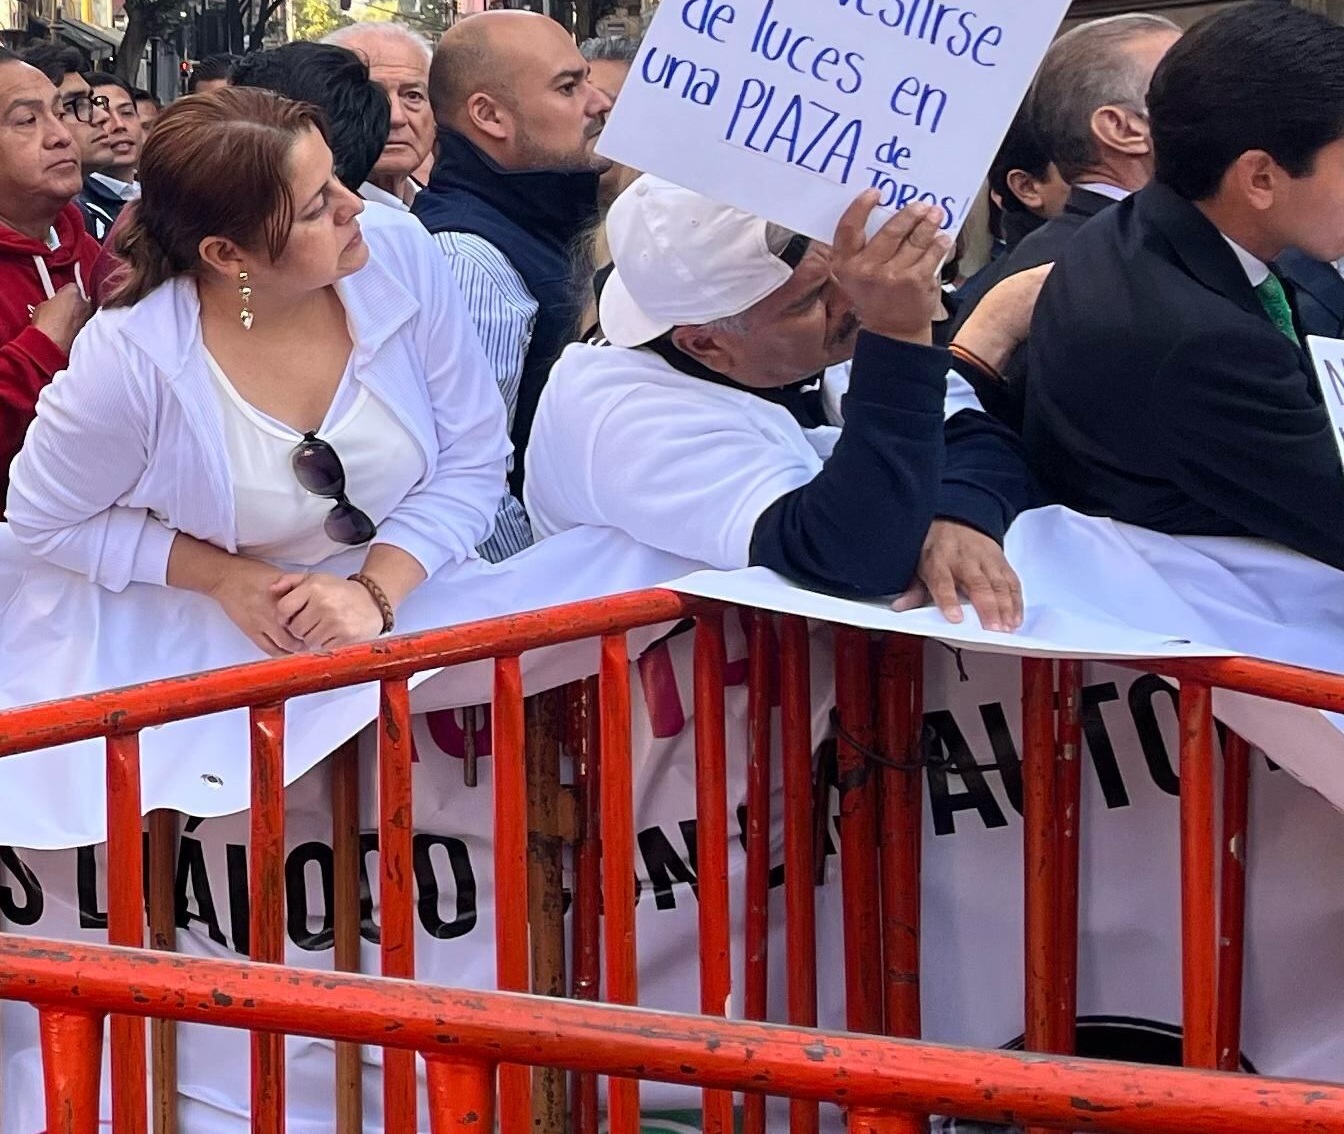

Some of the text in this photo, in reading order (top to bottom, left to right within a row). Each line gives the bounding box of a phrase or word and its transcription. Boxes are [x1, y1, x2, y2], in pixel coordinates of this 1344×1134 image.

[642, 46, 911, 185] una PLAZA de
[752, 0, 864, 94] luces
[890, 76, 947, 134] en
